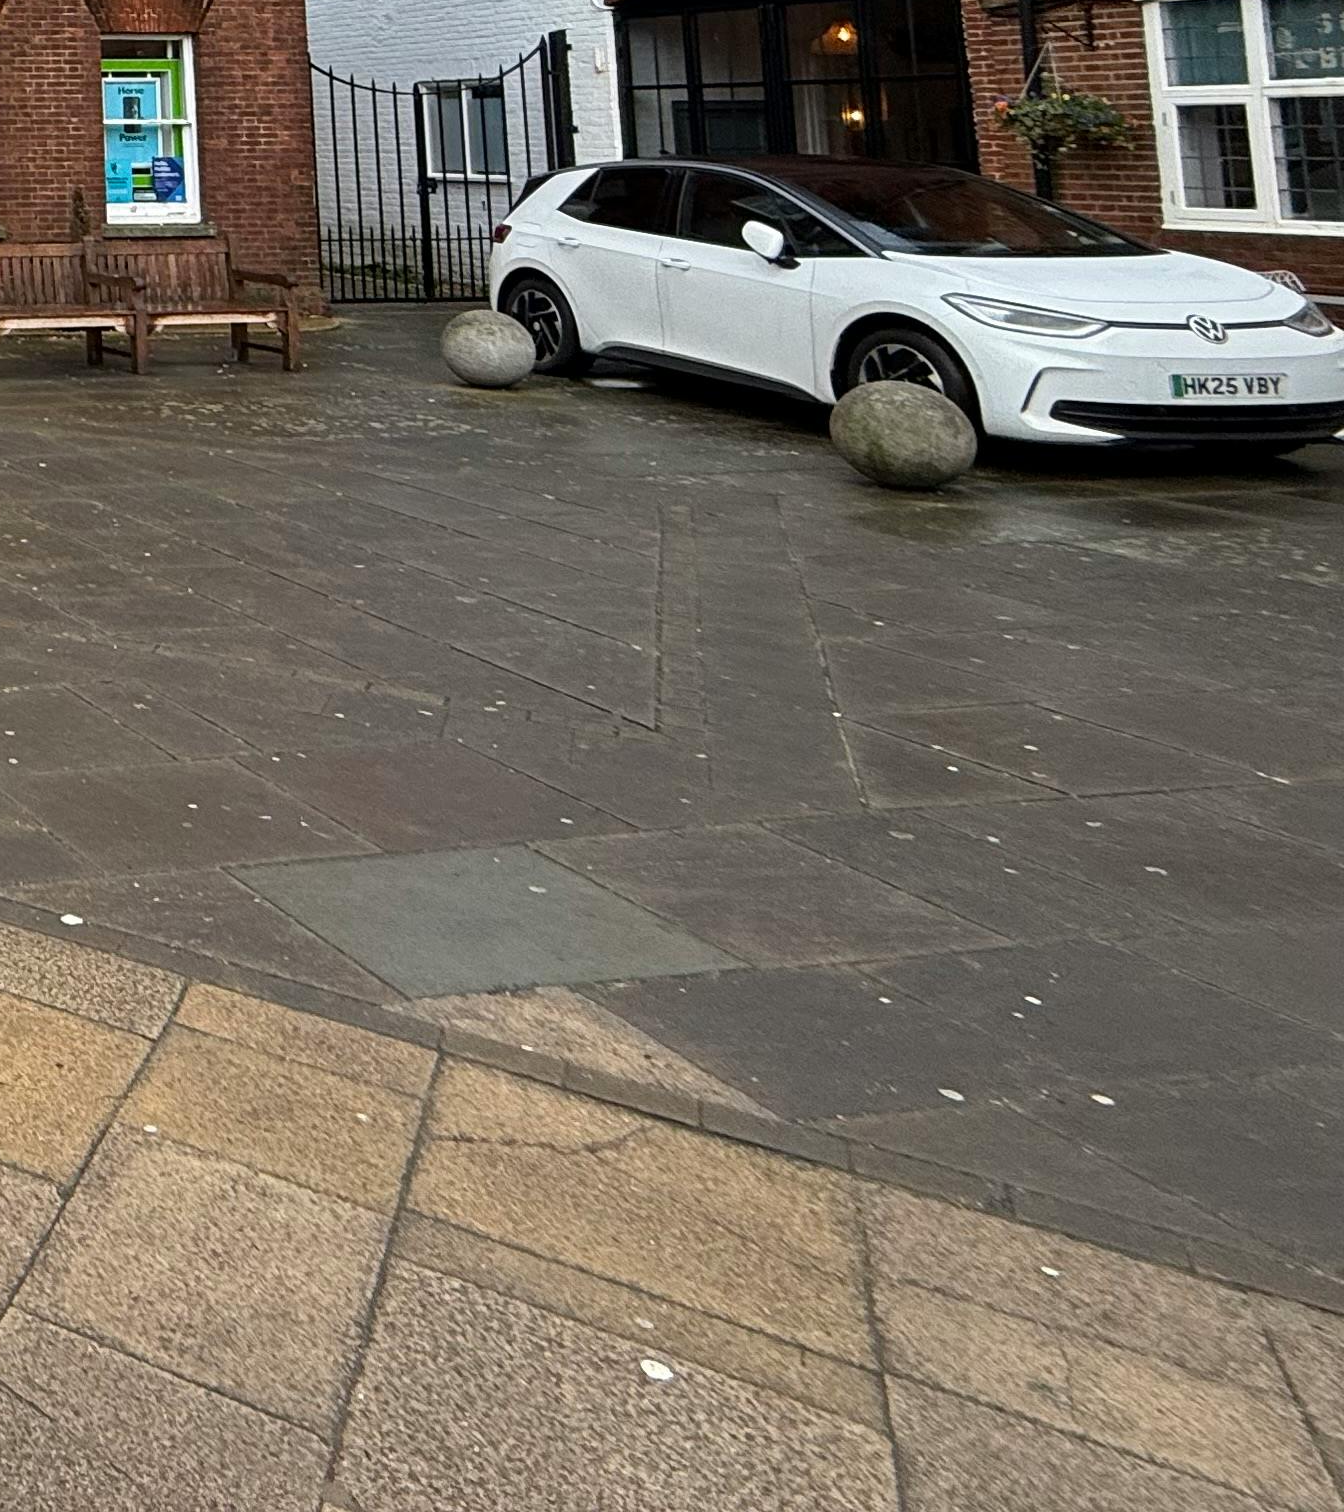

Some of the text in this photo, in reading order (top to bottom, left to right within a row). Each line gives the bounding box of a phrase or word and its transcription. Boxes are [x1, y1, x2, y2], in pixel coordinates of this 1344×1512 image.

[118, 86, 145, 95] Horse
[119, 133, 147, 142] Power
[1183, 376, 1281, 395] HK25 VBY
